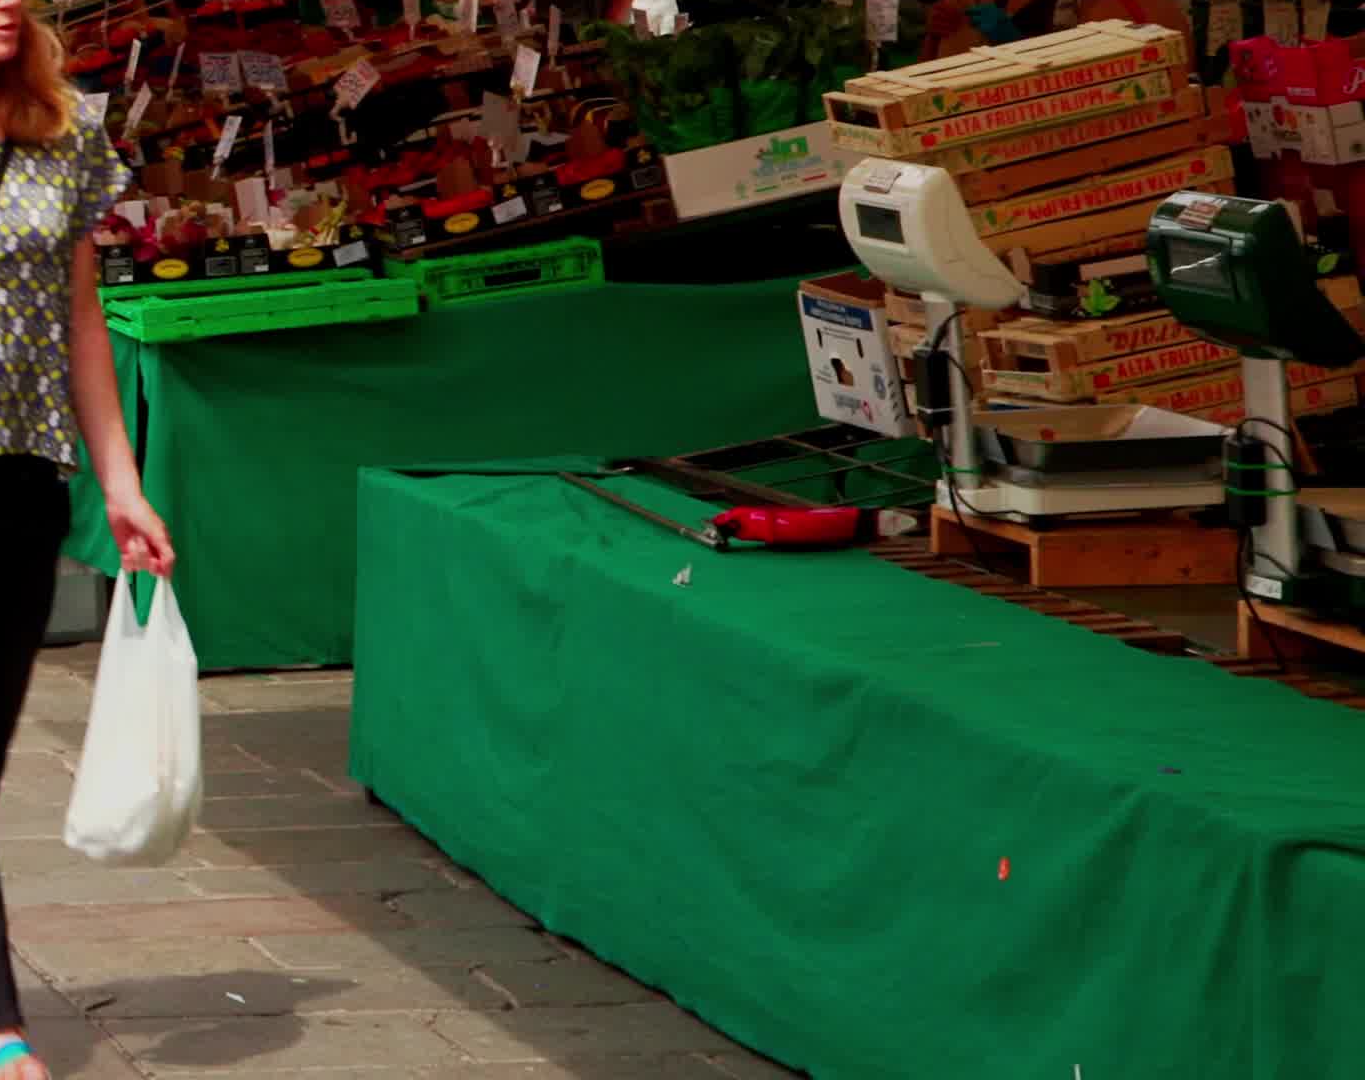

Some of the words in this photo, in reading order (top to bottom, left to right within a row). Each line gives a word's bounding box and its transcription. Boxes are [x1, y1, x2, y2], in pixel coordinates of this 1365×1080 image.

[1030, 63, 1095, 94] FRUTTA
[1094, 56, 1137, 80] ALTA
[975, 77, 1030, 106] FILIPPI
[943, 117, 982, 138] ALTA
[985, 101, 1048, 130] FRUTTA
[1050, 88, 1105, 116] FILIPPI
[1082, 179, 1142, 207] FRUTTA
[1141, 171, 1185, 195] ALTA
[1028, 194, 1082, 220] FILIPPI
[1117, 356, 1155, 379] ALTA
[1157, 343, 1222, 369] FRUTTA
